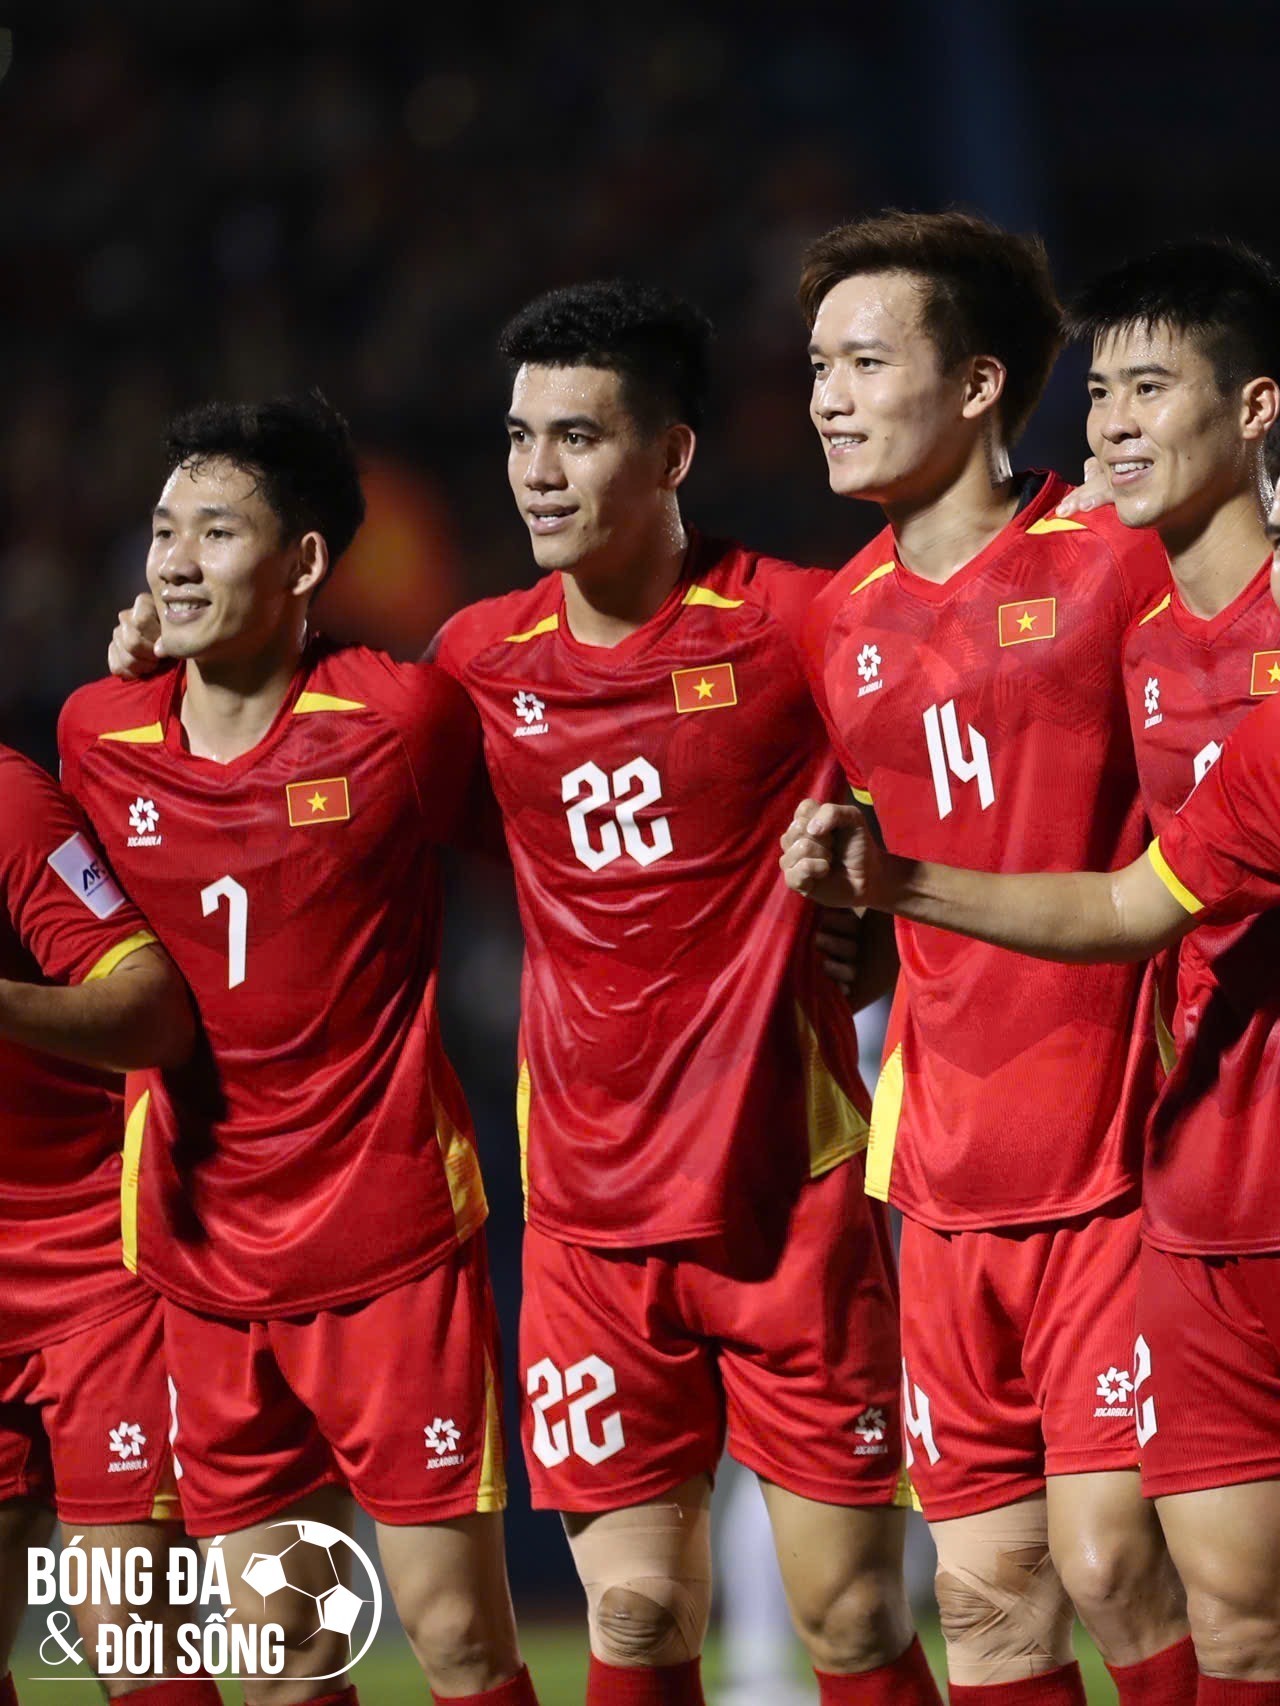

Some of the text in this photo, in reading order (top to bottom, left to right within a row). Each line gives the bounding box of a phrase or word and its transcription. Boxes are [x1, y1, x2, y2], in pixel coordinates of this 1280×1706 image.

[561, 756, 674, 873] 22
[922, 700, 995, 820] 14
[200, 875, 248, 989] 7
[107, 1459, 148, 1473] JOGARBOLA
[426, 1455, 464, 1470] JOGARBOLA
[526, 1354, 625, 1469] 22
[1093, 1407, 1135, 1418] JOGARBOLA
